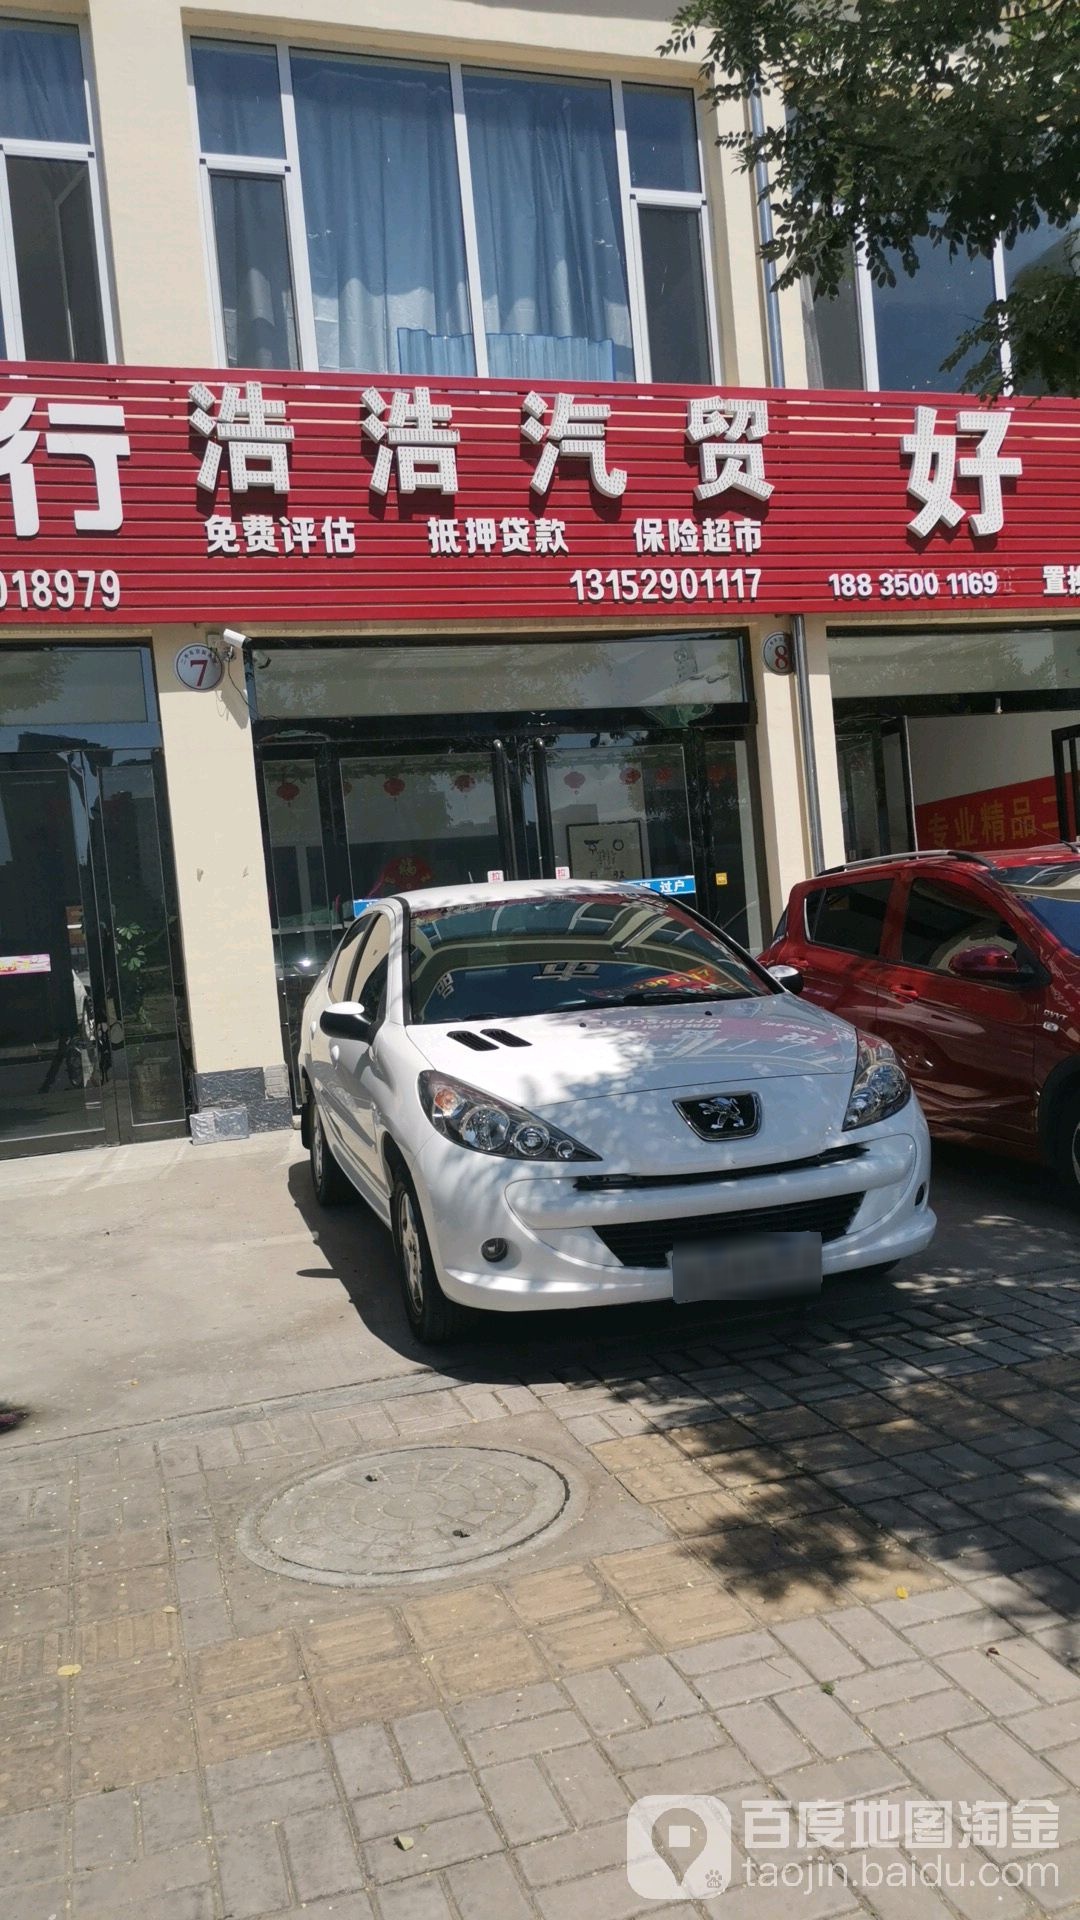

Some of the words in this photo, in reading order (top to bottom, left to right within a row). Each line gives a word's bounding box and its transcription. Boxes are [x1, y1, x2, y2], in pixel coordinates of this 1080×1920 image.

[188, 381, 775, 501] 浩浩汽贸
[0, 396, 130, 537] 行
[902, 405, 1023, 537] 好
[205, 514, 356, 554] 免费评估
[427, 516, 569, 554] 抵押贷款
[633, 517, 762, 553] 保险超市
[570, 568, 761, 600] 13152901117
[828, 573, 873, 597] 188
[878, 572, 939, 597] 3500
[946, 571, 998, 595] 1169
[190, 659, 208, 687] 7
[774, 645, 788, 669] 8
[660, 881, 686, 893] 过户
